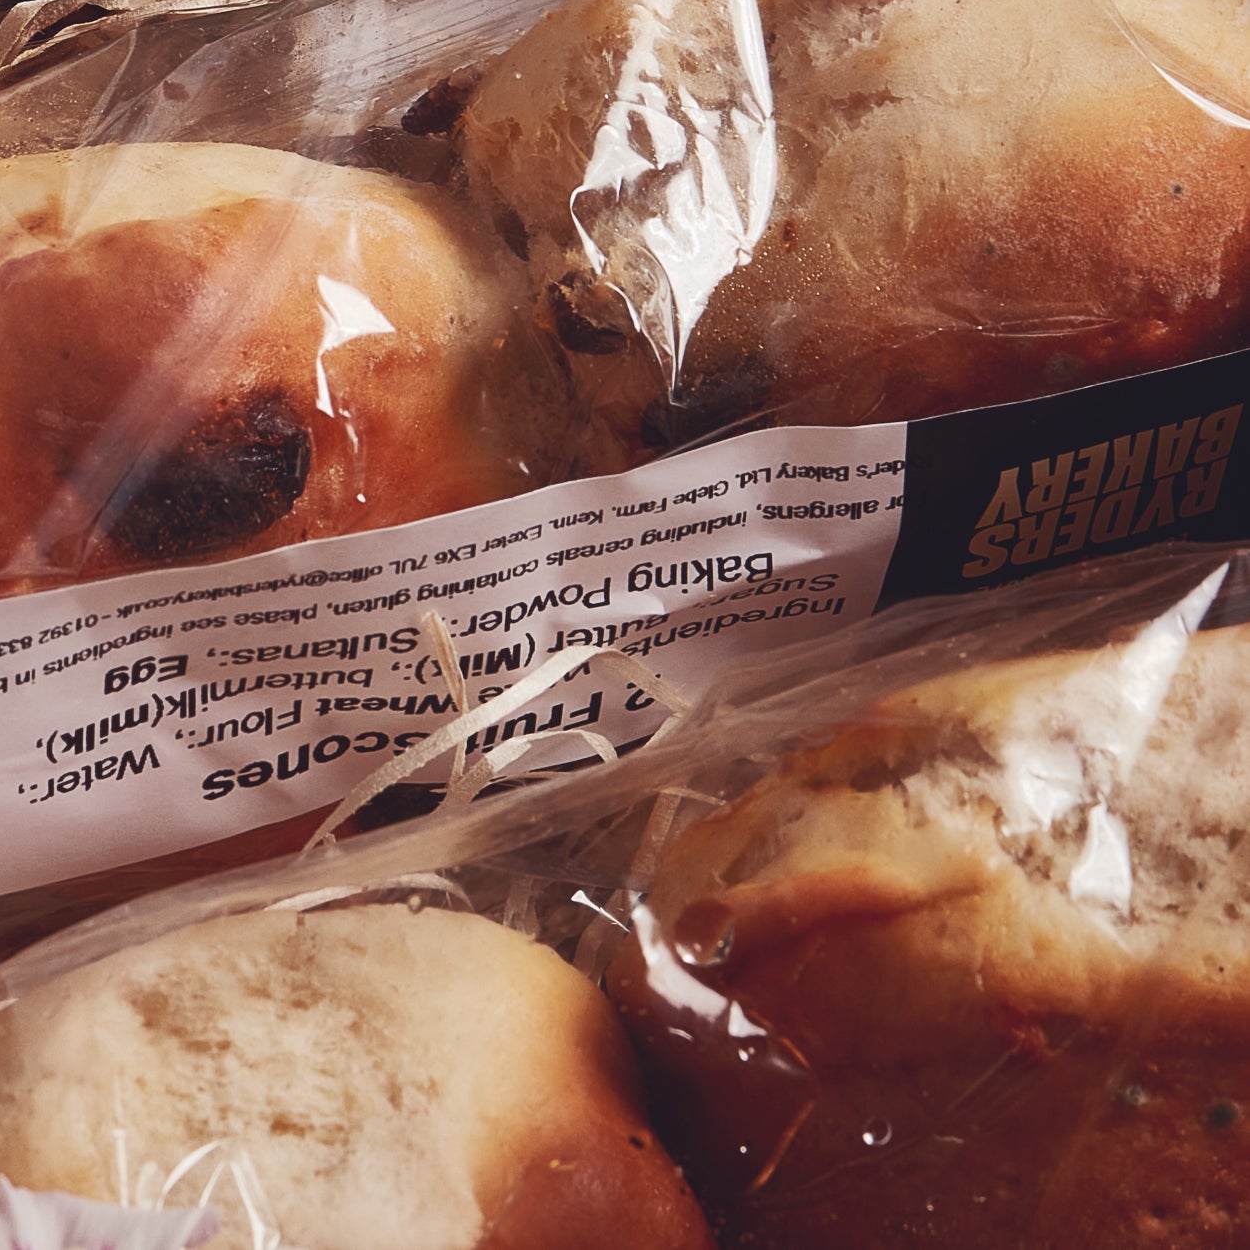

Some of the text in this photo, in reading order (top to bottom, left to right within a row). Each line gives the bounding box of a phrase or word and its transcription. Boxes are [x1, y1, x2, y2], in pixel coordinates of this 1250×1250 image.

[776, 462, 849, 482] Bakery
[974, 403, 1244, 529] BAKERY
[673, 481, 728, 504] Glebe
[756, 500, 879, 520] allergens,
[962, 458, 1229, 578] RYDERS
[481, 524, 542, 552] Exeter
[640, 511, 747, 546] including
[389, 554, 428, 574] 7UL
[546, 538, 634, 566] cereals
[417, 559, 538, 601] containing
[628, 553, 772, 594] Baking
[234, 603, 318, 626] please
[327, 588, 411, 615] gluten,
[180, 616, 227, 632] see
[38, 625, 173, 675] ingredients
[16, 669, 35, 685] in
[104, 655, 188, 695] Egg
[315, 693, 458, 716] Wheat
[19, 744, 160, 804] Water:,
